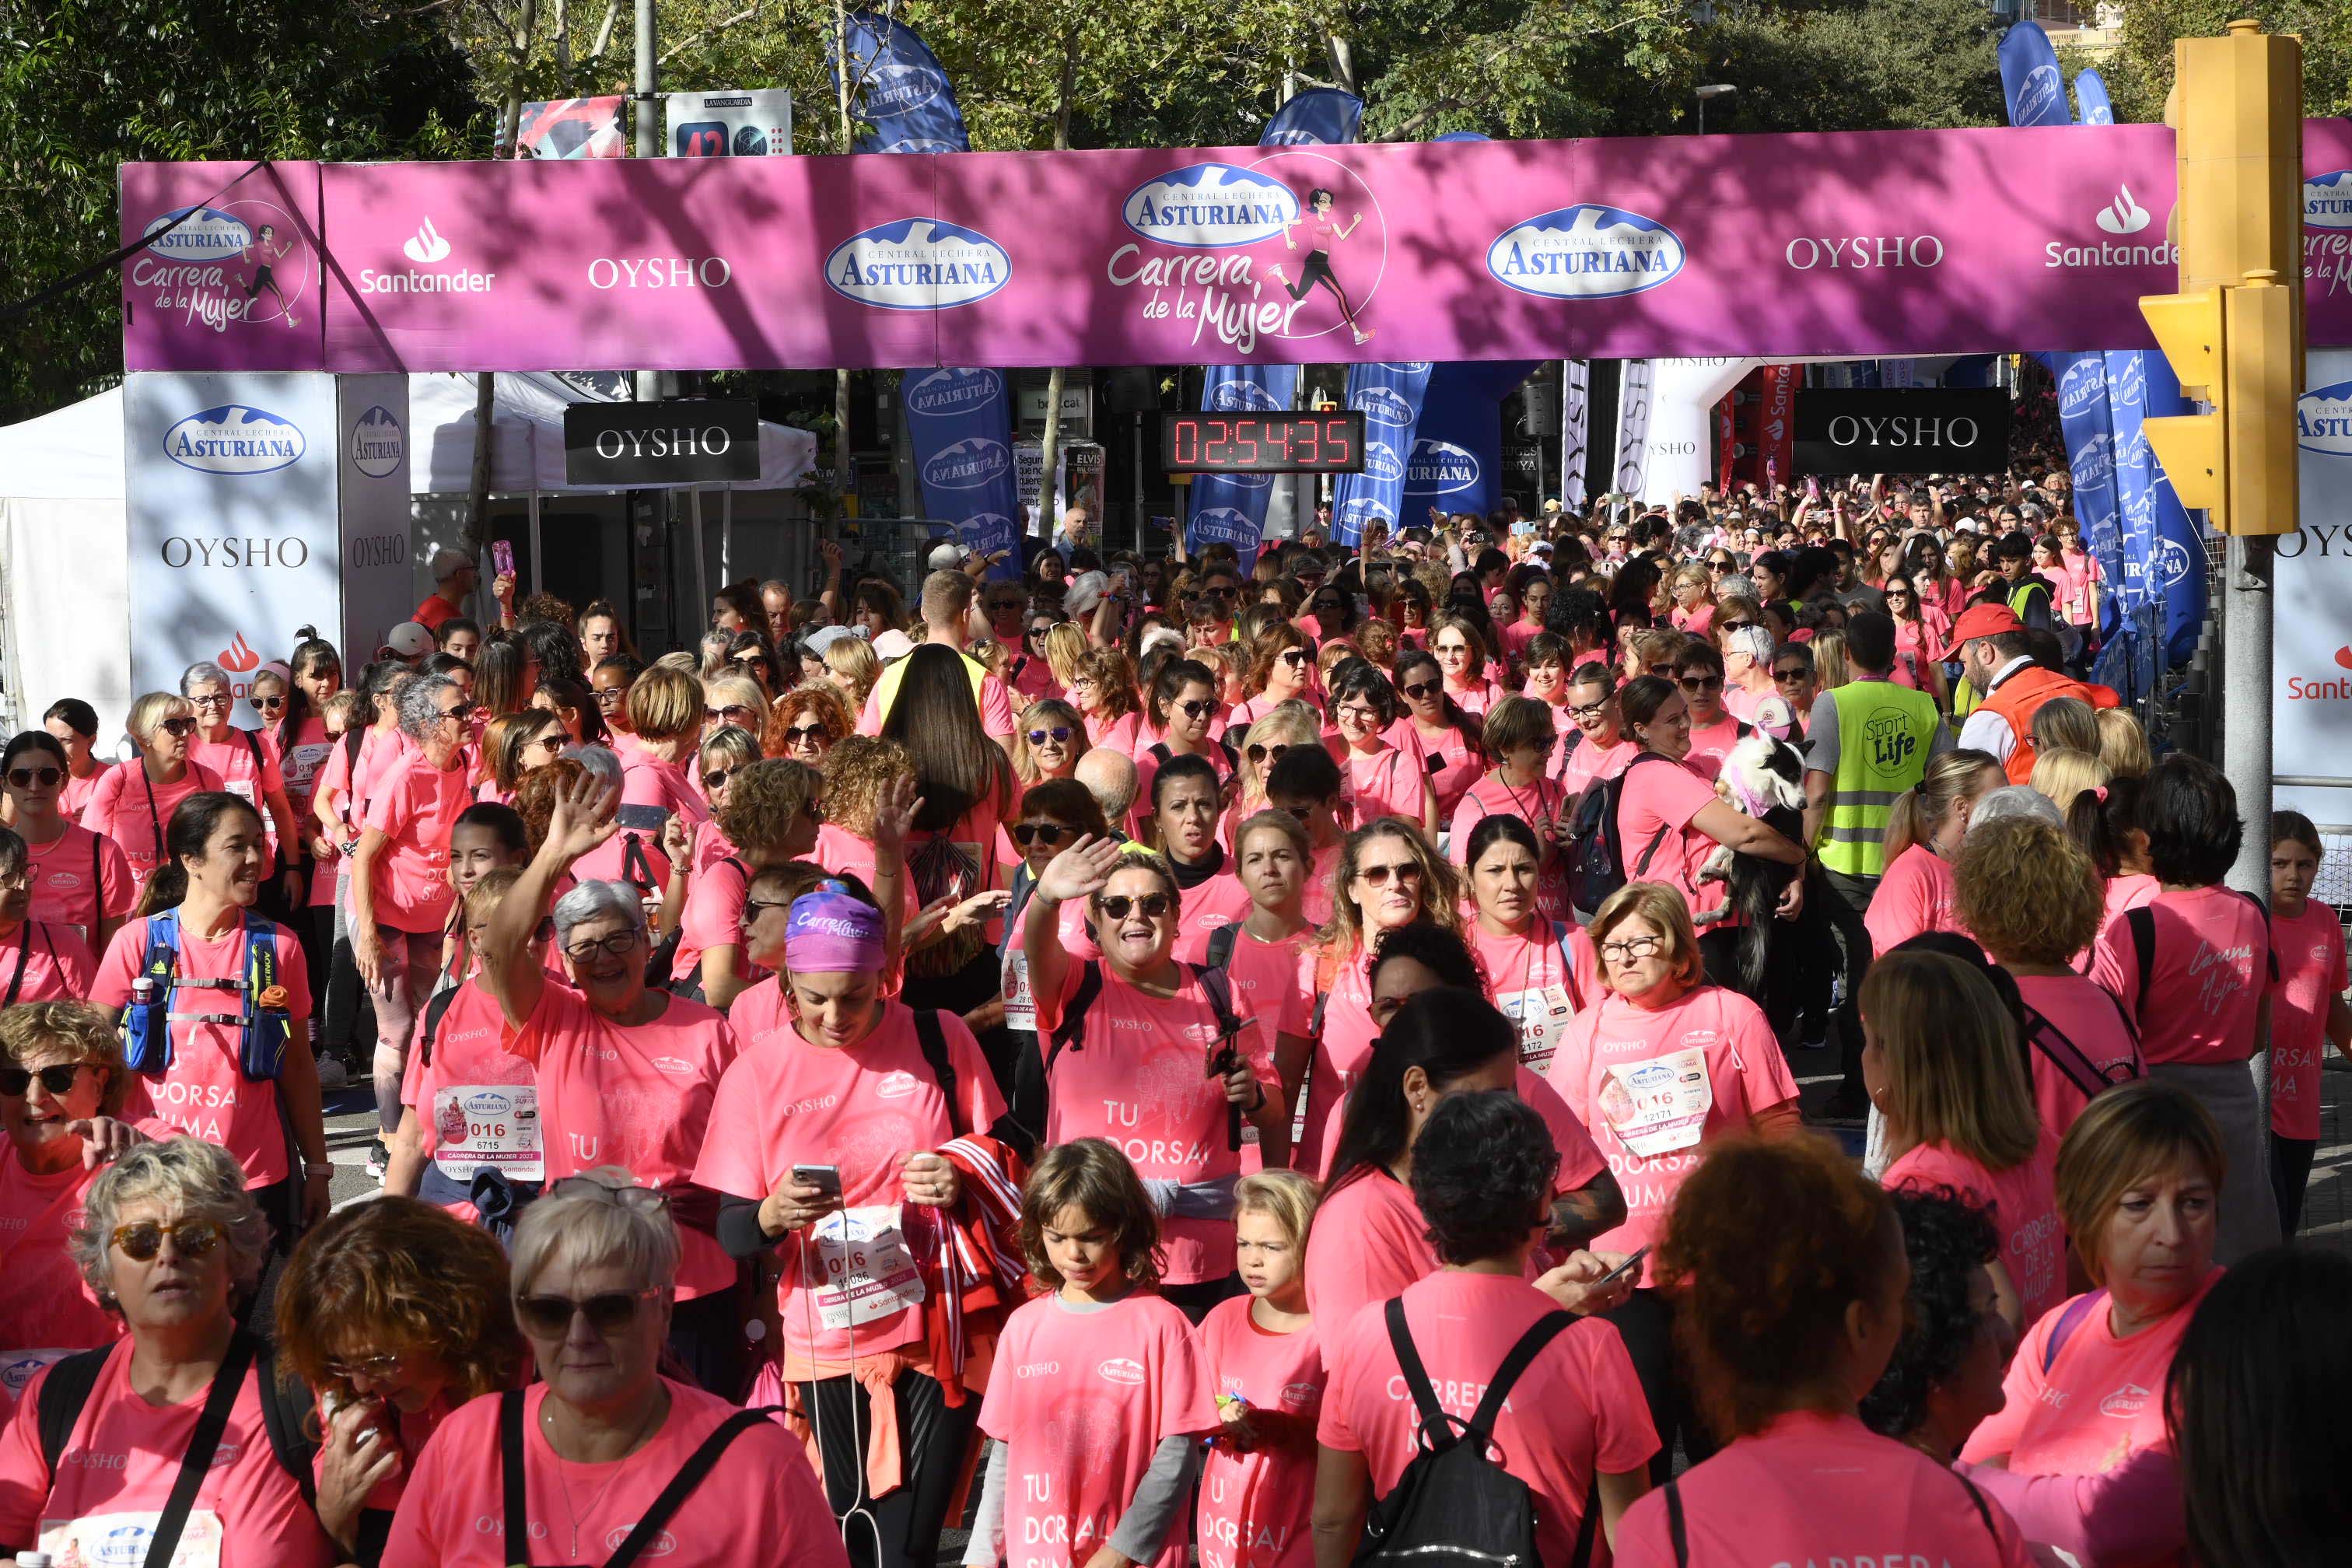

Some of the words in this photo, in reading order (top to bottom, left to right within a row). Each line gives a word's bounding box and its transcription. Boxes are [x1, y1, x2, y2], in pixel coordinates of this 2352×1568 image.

[1163, 192, 1219, 201] CENTRAL
[1223, 191, 1283, 201] LECHERA
[1136, 194, 1285, 226] ASTURIANA
[868, 249, 926, 257] CENTRAL
[931, 249, 991, 257] LECHERA
[1533, 237, 1594, 247] CENTRAL
[1600, 235, 1664, 247] LECHERA
[1786, 235, 1944, 270] OYSHO
[838, 251, 997, 286] ASTURIANA
[1107, 243, 1252, 286] Carrera
[1501, 240, 1671, 276] ASTURIANA
[2318, 257, 2332, 278] la
[132, 257, 223, 287] Carrera
[360, 268, 495, 293] Santander
[588, 257, 731, 290] OYSHO
[156, 288, 172, 308] de
[175, 287, 187, 309] la
[185, 285, 260, 333] Mujer
[1143, 289, 1170, 319] de
[1176, 288, 1195, 319] la
[1192, 281, 1307, 355] Mujer
[1355, 395, 1409, 422] ASTURIANA
[174, 431, 296, 457] ASTURIANA
[596, 425, 730, 460] OYSHO
[1175, 421, 1349, 464] 02:54:35
[1828, 415, 1979, 448] OYSHO
[355, 433, 401, 460] ASTURIANA
[1076, 453, 1101, 464] ELVIS
[1019, 467, 1031, 476] que
[160, 537, 309, 569] OYSHO
[353, 534, 404, 569] OYSHO
[1867, 713, 1908, 740] Sport
[1874, 732, 1915, 765] Life
[2189, 939, 2253, 976] Carrera
[447, 1028, 489, 1044] OYSHO
[1602, 1039, 1647, 1053] OYSHO
[468, 1101, 508, 1111] ASTURIANA
[783, 1095, 837, 1118] OYSHO
[1103, 1100, 1139, 1127] TU
[1644, 1109, 1671, 1122] 12171
[471, 1124, 506, 1137] 016
[477, 1141, 499, 1150] 6715
[569, 1132, 598, 1160] TU
[828, 1251, 866, 1274] 016
[877, 1287, 916, 1307] Santander
[1017, 1362, 1059, 1379] OYSHO
[68, 1447, 128, 1469] OYSHO
[1023, 1472, 1050, 1503] TU
